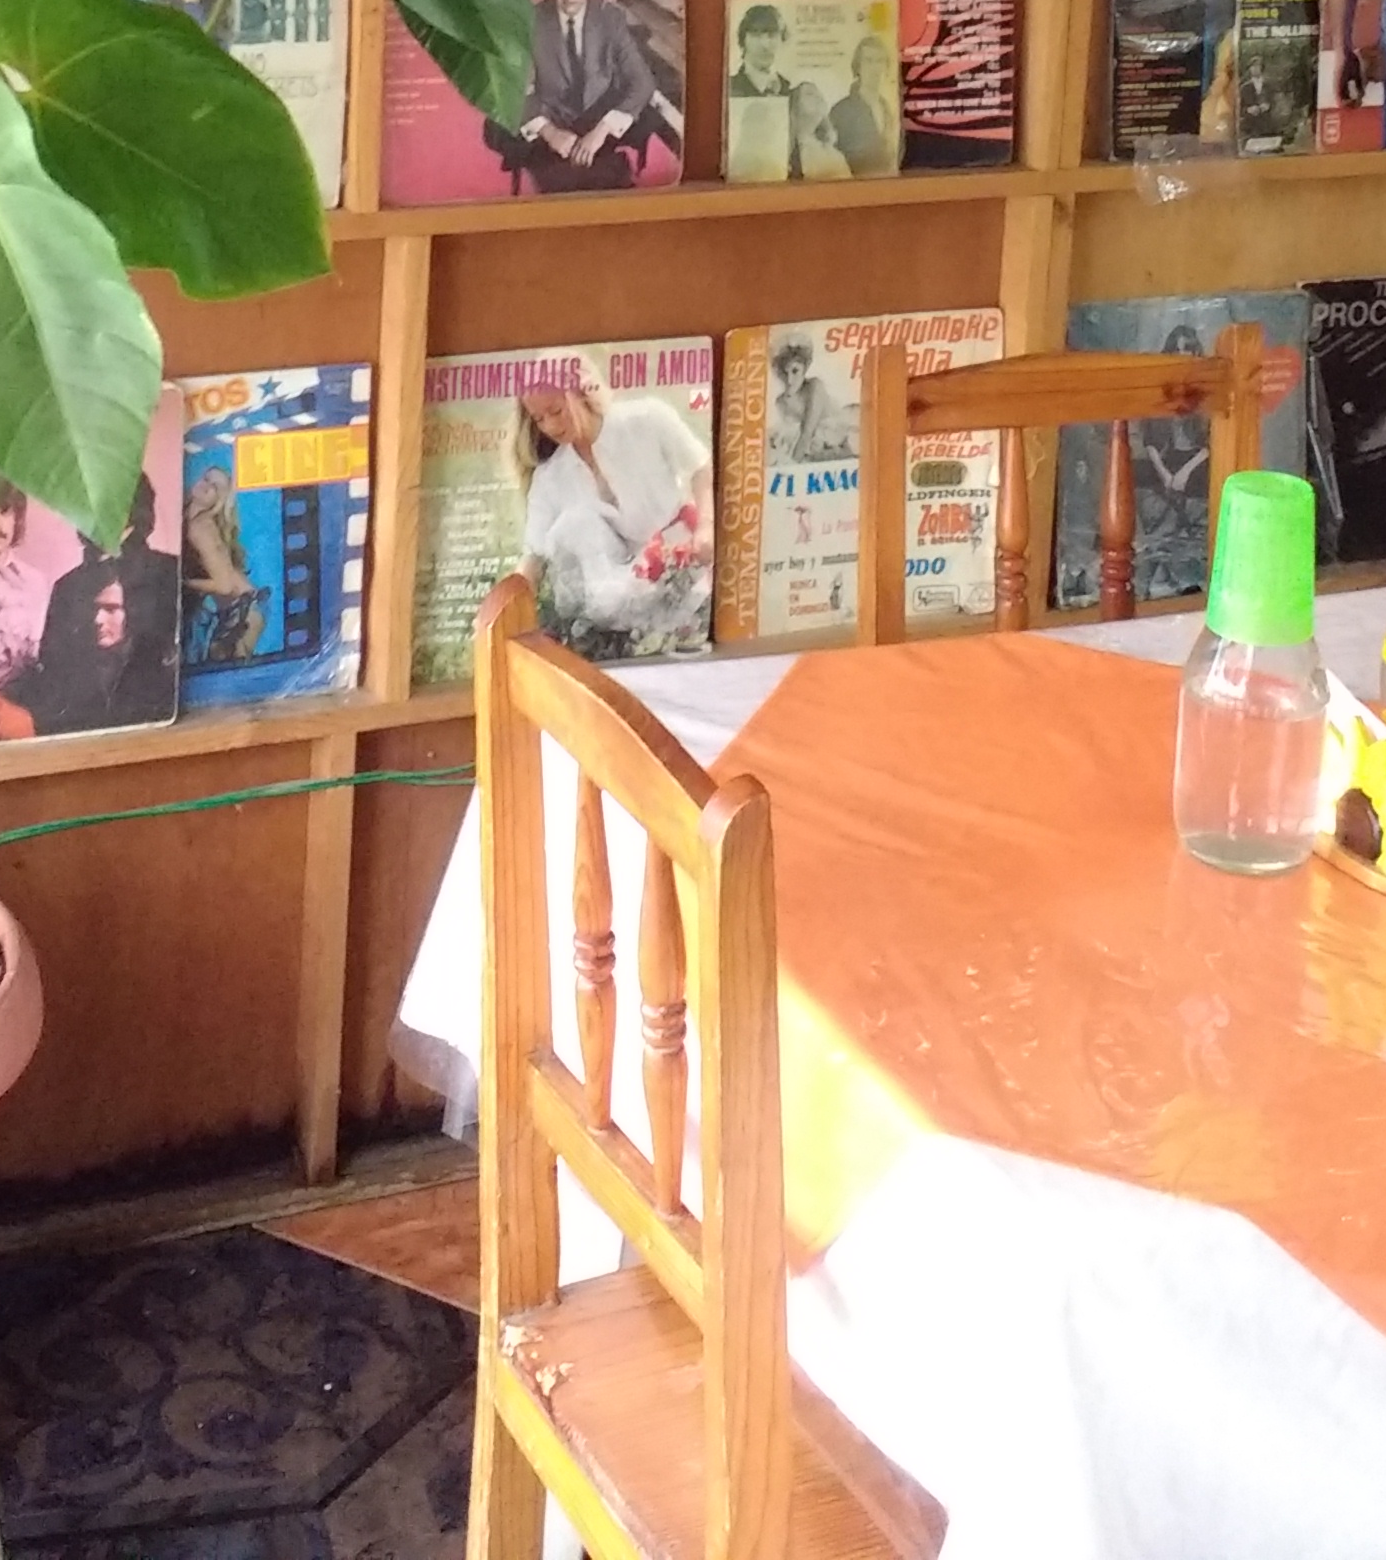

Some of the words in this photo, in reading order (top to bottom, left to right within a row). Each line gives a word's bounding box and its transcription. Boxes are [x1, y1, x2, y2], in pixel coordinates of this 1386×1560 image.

[1245, 26, 1268, 38] THE
[185, 376, 250, 421] TOS
[425, 357, 600, 402] NSTRUMENTALES...
[610, 351, 647, 390] CON
[656, 348, 711, 387] AMOR
[745, 338, 766, 422] CINE
[721, 359, 745, 532] GRANDES
[744, 426, 763, 498] DEL
[806, 468, 859, 496] KNAC
[907, 489, 992, 501] LDFINGER
[719, 542, 740, 607] LOS
[739, 503, 761, 627] TEMAS
